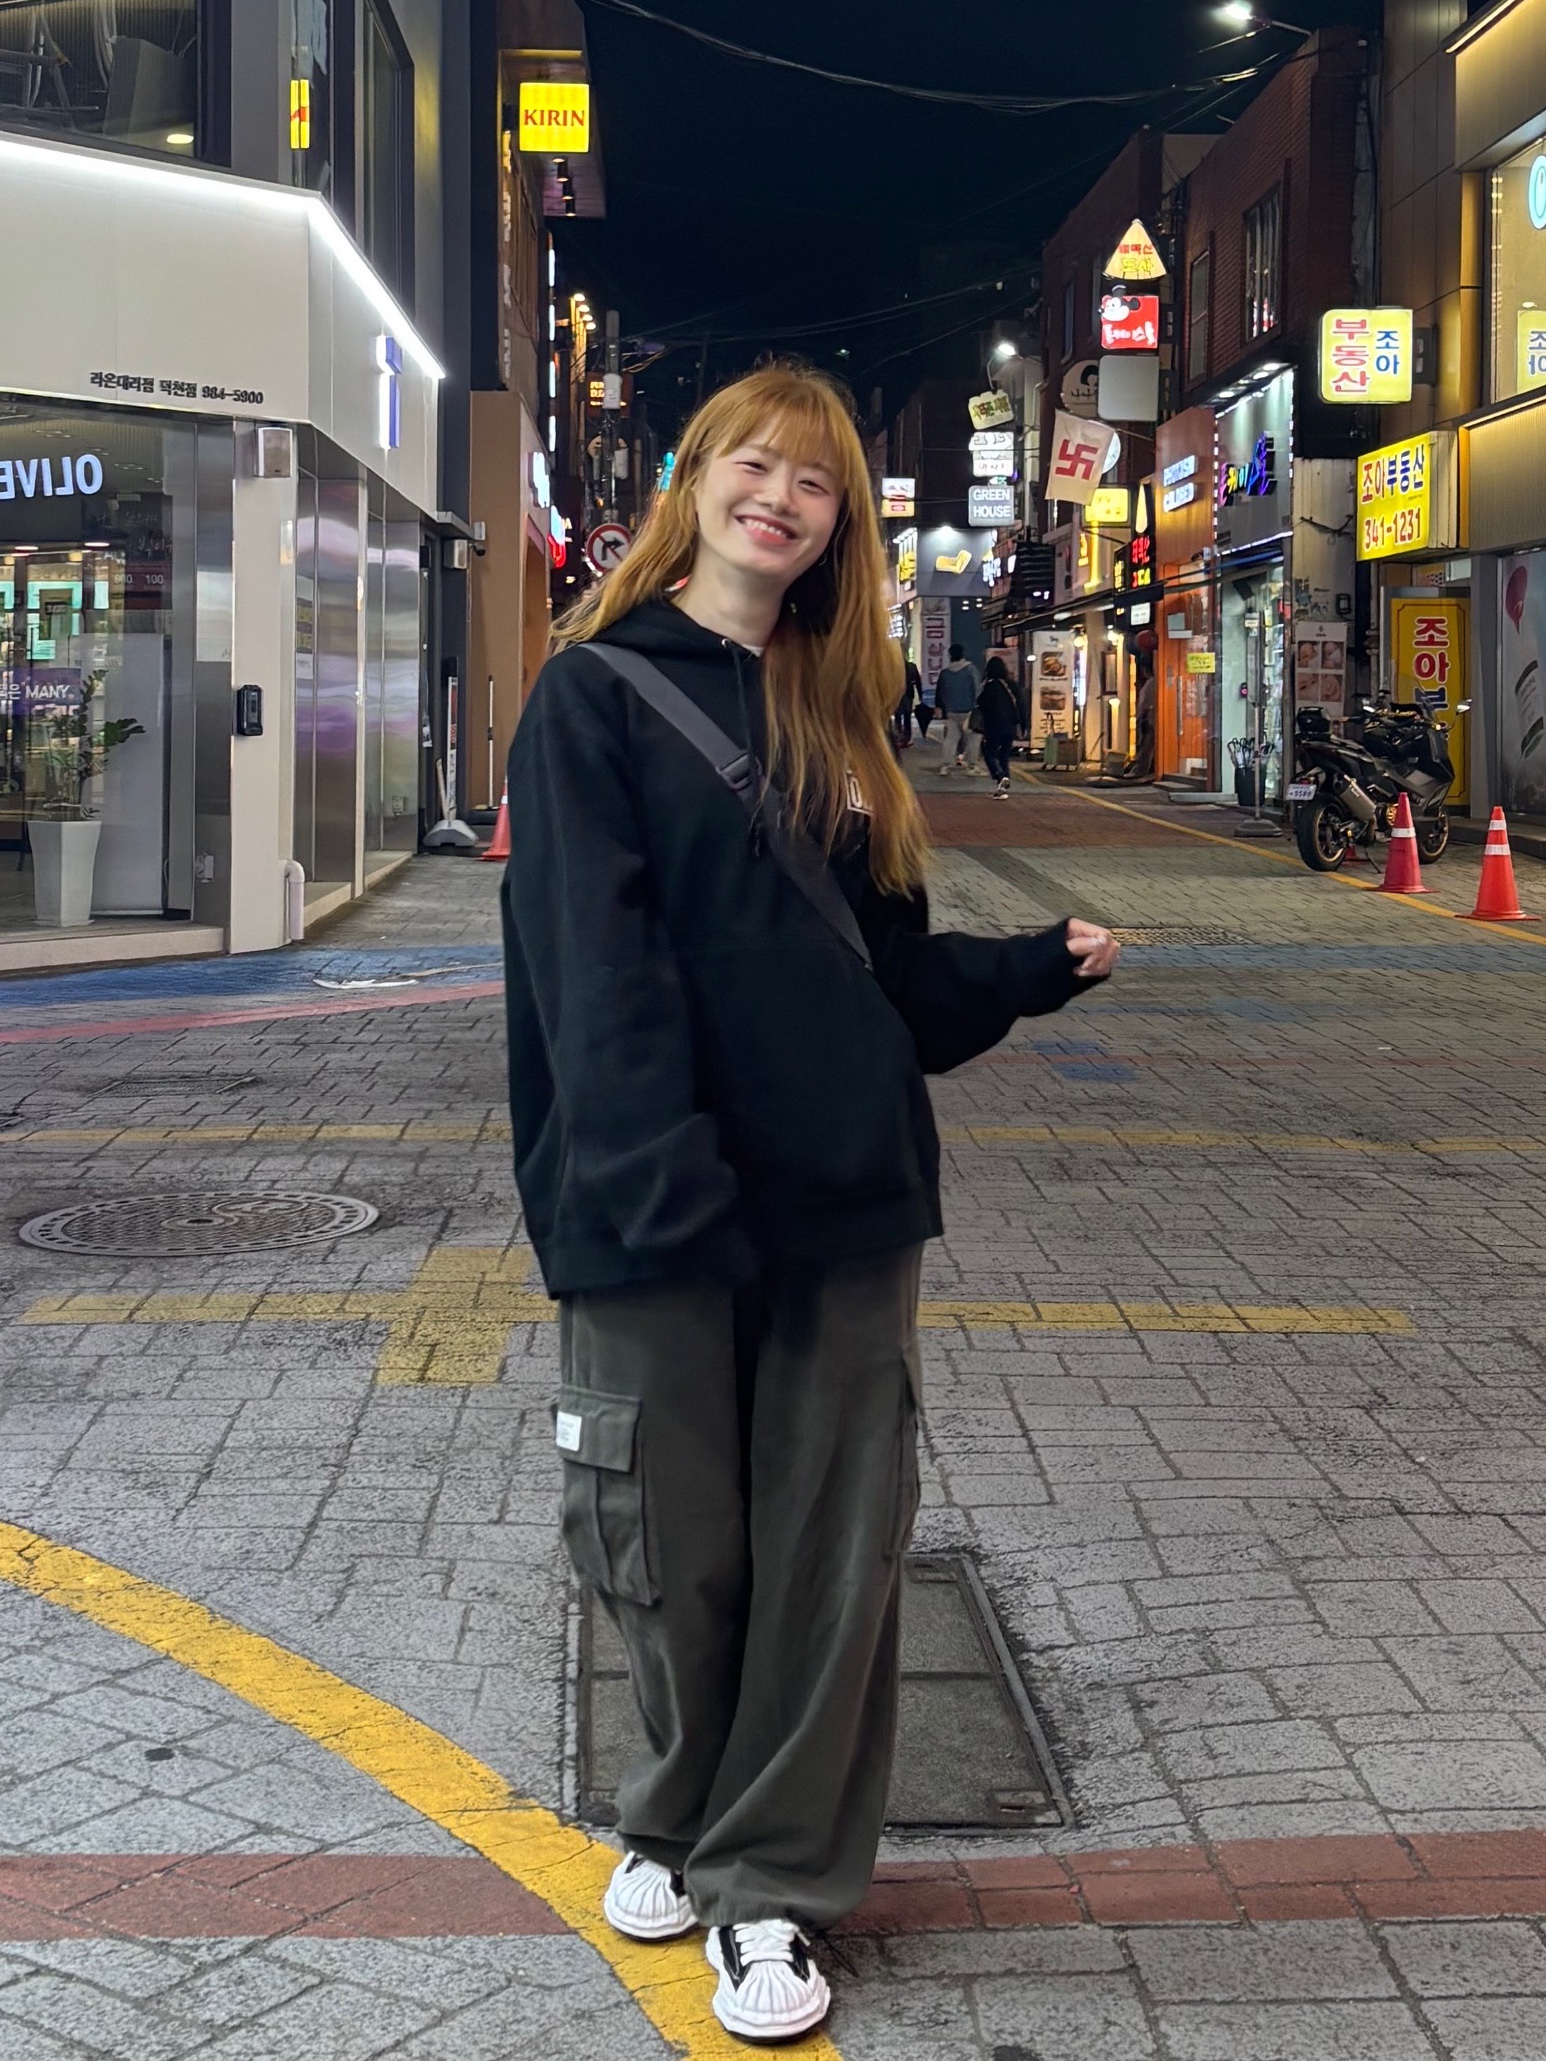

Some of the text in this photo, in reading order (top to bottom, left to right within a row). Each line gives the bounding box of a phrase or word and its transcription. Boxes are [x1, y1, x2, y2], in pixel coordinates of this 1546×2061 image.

[524, 109, 585, 127] KIRIN
[1332, 319, 1370, 393] 부동산
[1375, 330, 1400, 375] 조아
[159, 379, 198, 399] 덕천점
[1362, 443, 1425, 503] 조아부동산
[973, 488, 1010, 502] GREEN
[973, 504, 1012, 518] HOUSE
[1365, 507, 1421, 549] 341-1231
